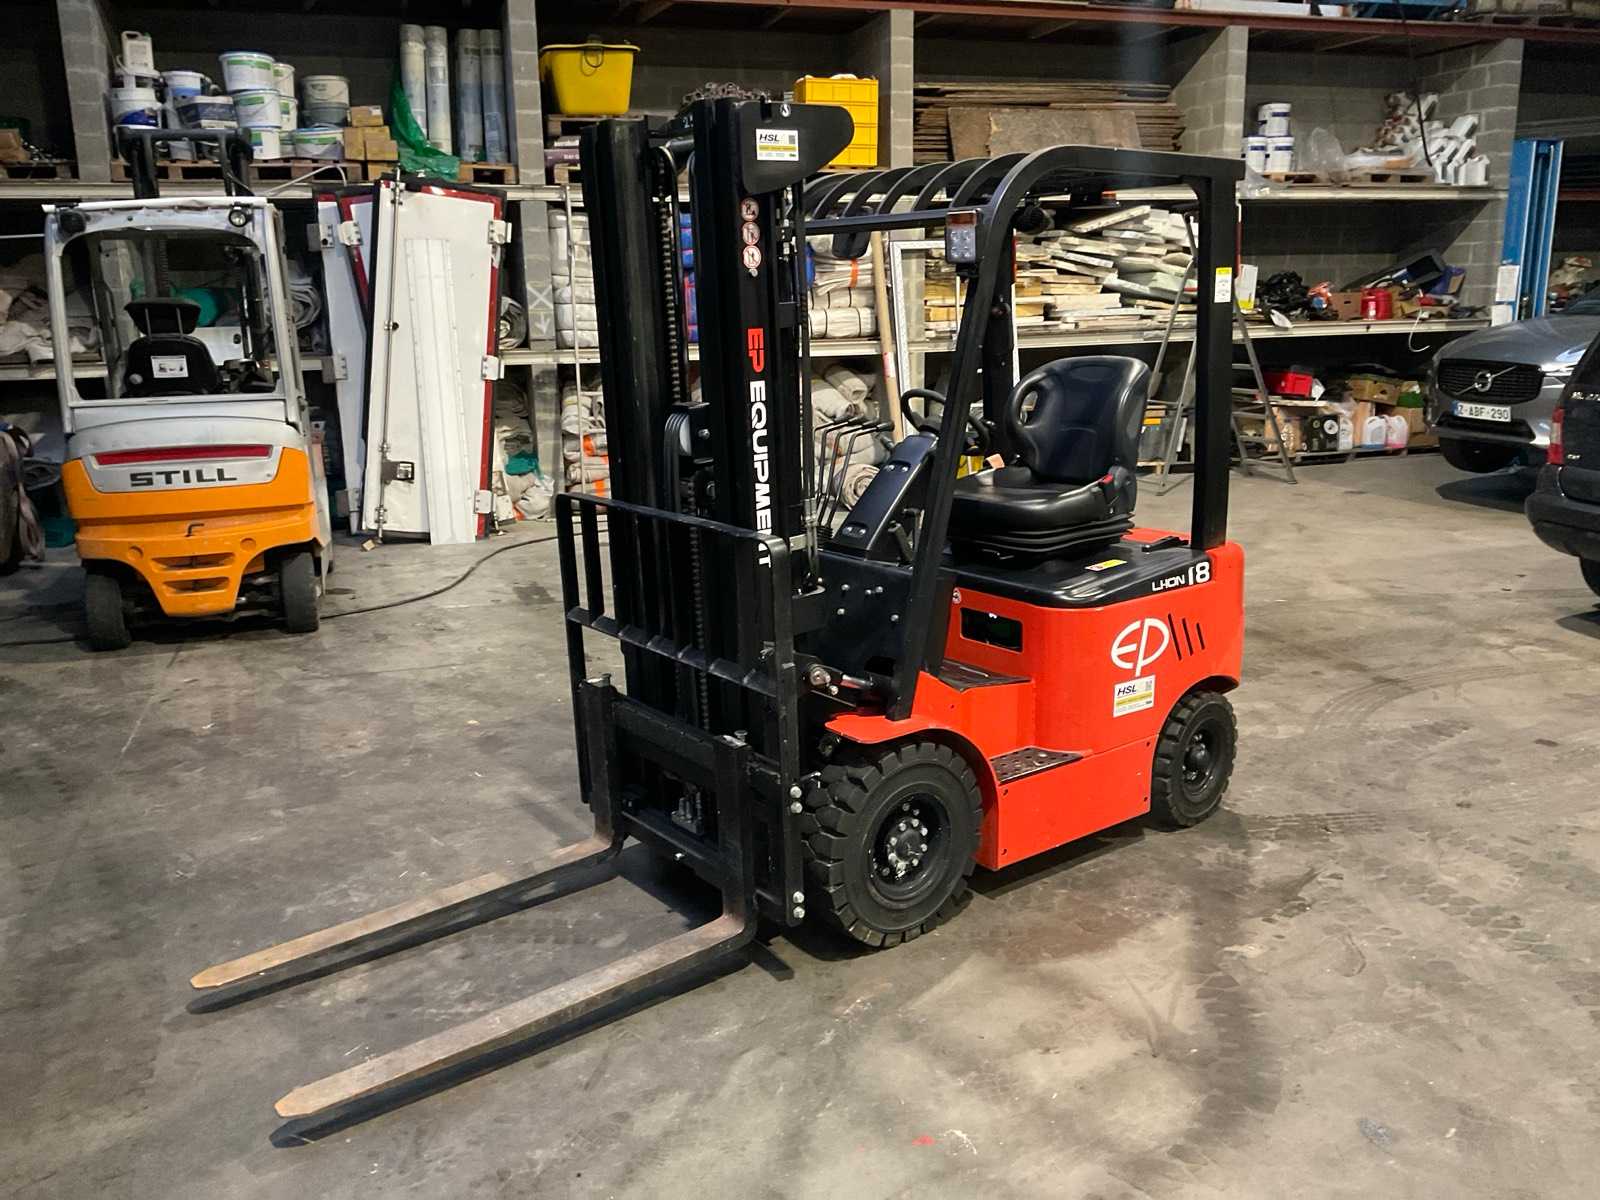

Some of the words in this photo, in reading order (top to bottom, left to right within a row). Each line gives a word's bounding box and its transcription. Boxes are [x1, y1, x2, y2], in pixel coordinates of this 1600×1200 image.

[759, 133, 780, 142] HSL
[747, 327, 765, 373] EP
[130, 468, 237, 487] STILL
[1187, 561, 1210, 586] 18
[1110, 617, 1170, 677] EP
[1117, 684, 1137, 697] HSL
